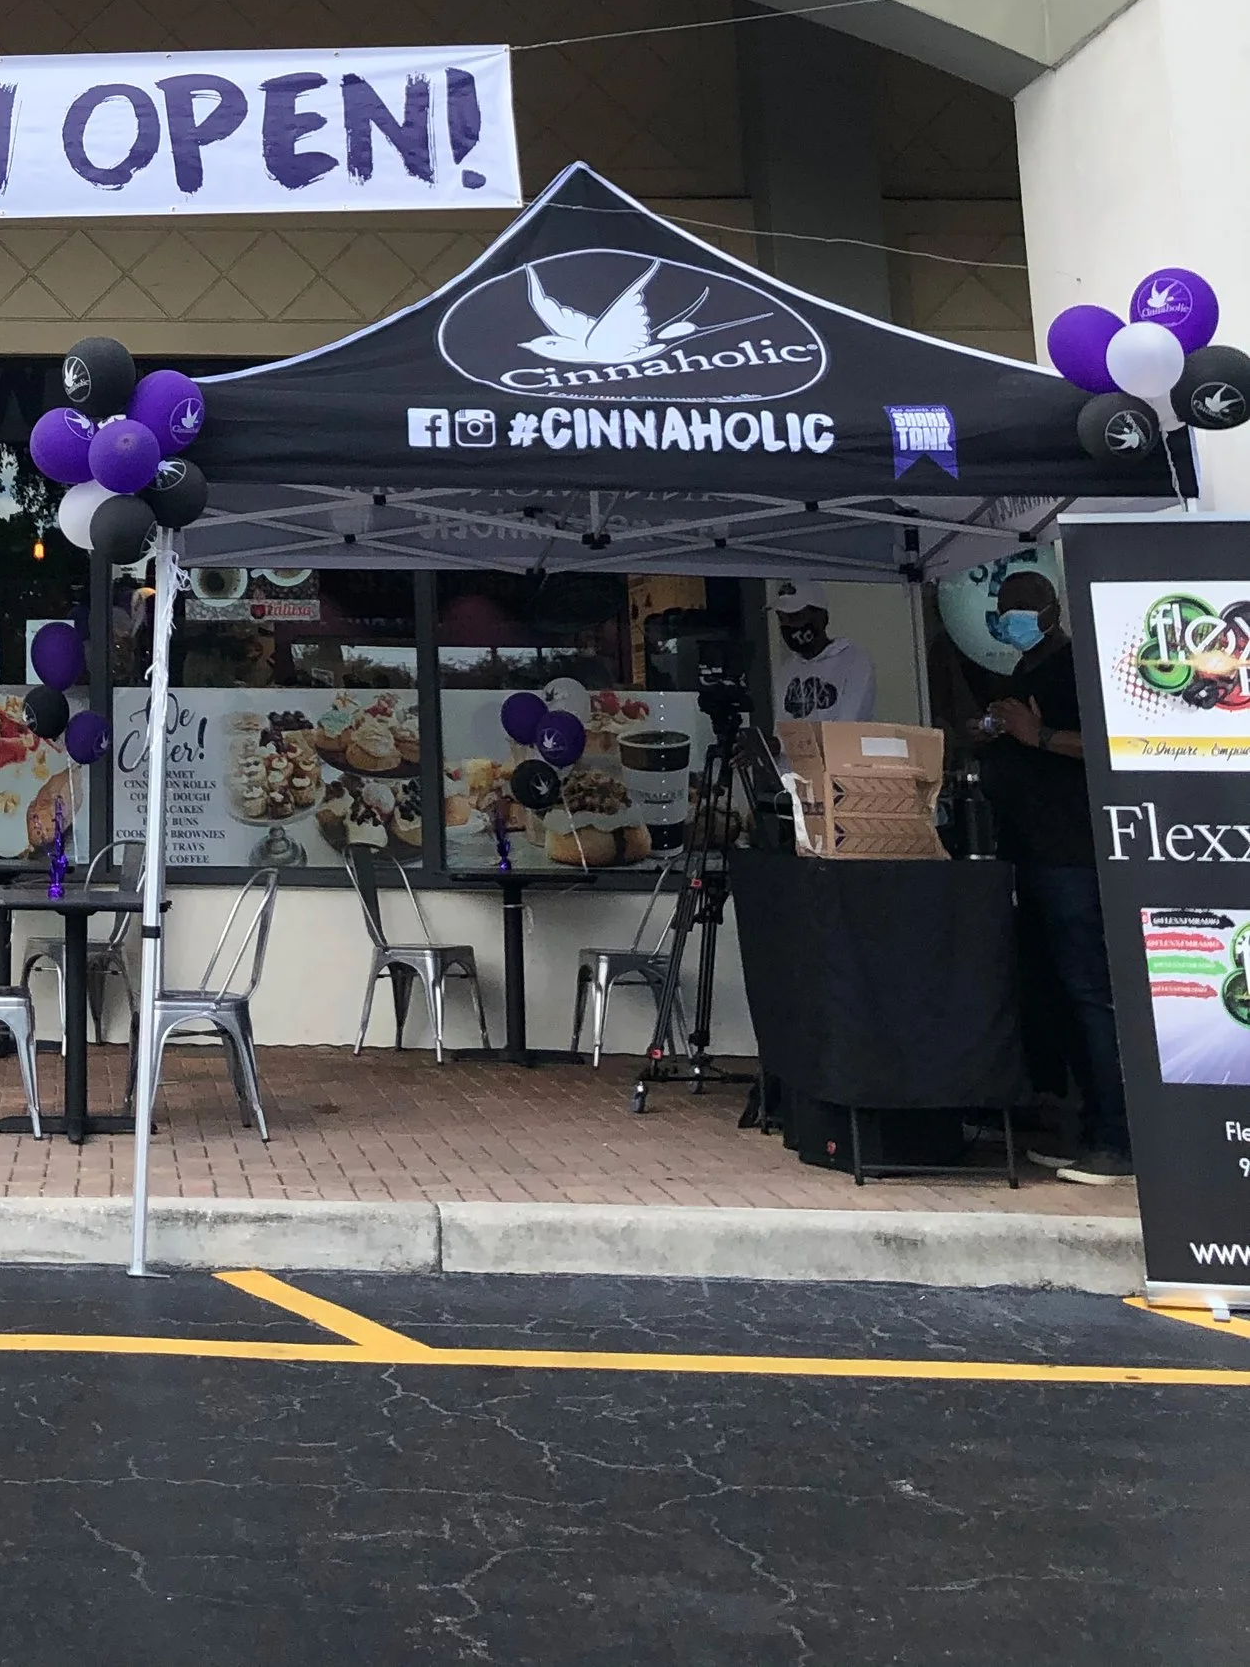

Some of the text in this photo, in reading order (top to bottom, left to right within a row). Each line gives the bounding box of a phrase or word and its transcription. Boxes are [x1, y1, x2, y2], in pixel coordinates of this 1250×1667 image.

[61, 67, 487, 196] OPEN!
[500, 339, 812, 389] Cinnaholic
[892, 412, 950, 427] SHARK
[508, 406, 836, 454] #CINNAHOLIC
[895, 427, 953, 451] TANK
[142, 770, 195, 779] GRMET
[183, 780, 217, 789] ROLLS
[173, 792, 210, 801] DOUGH
[172, 817, 199, 826] BUNS
[170, 829, 226, 839] BROWNIES
[172, 842, 205, 851] TRAYS
[169, 854, 210, 864] COFFEE
